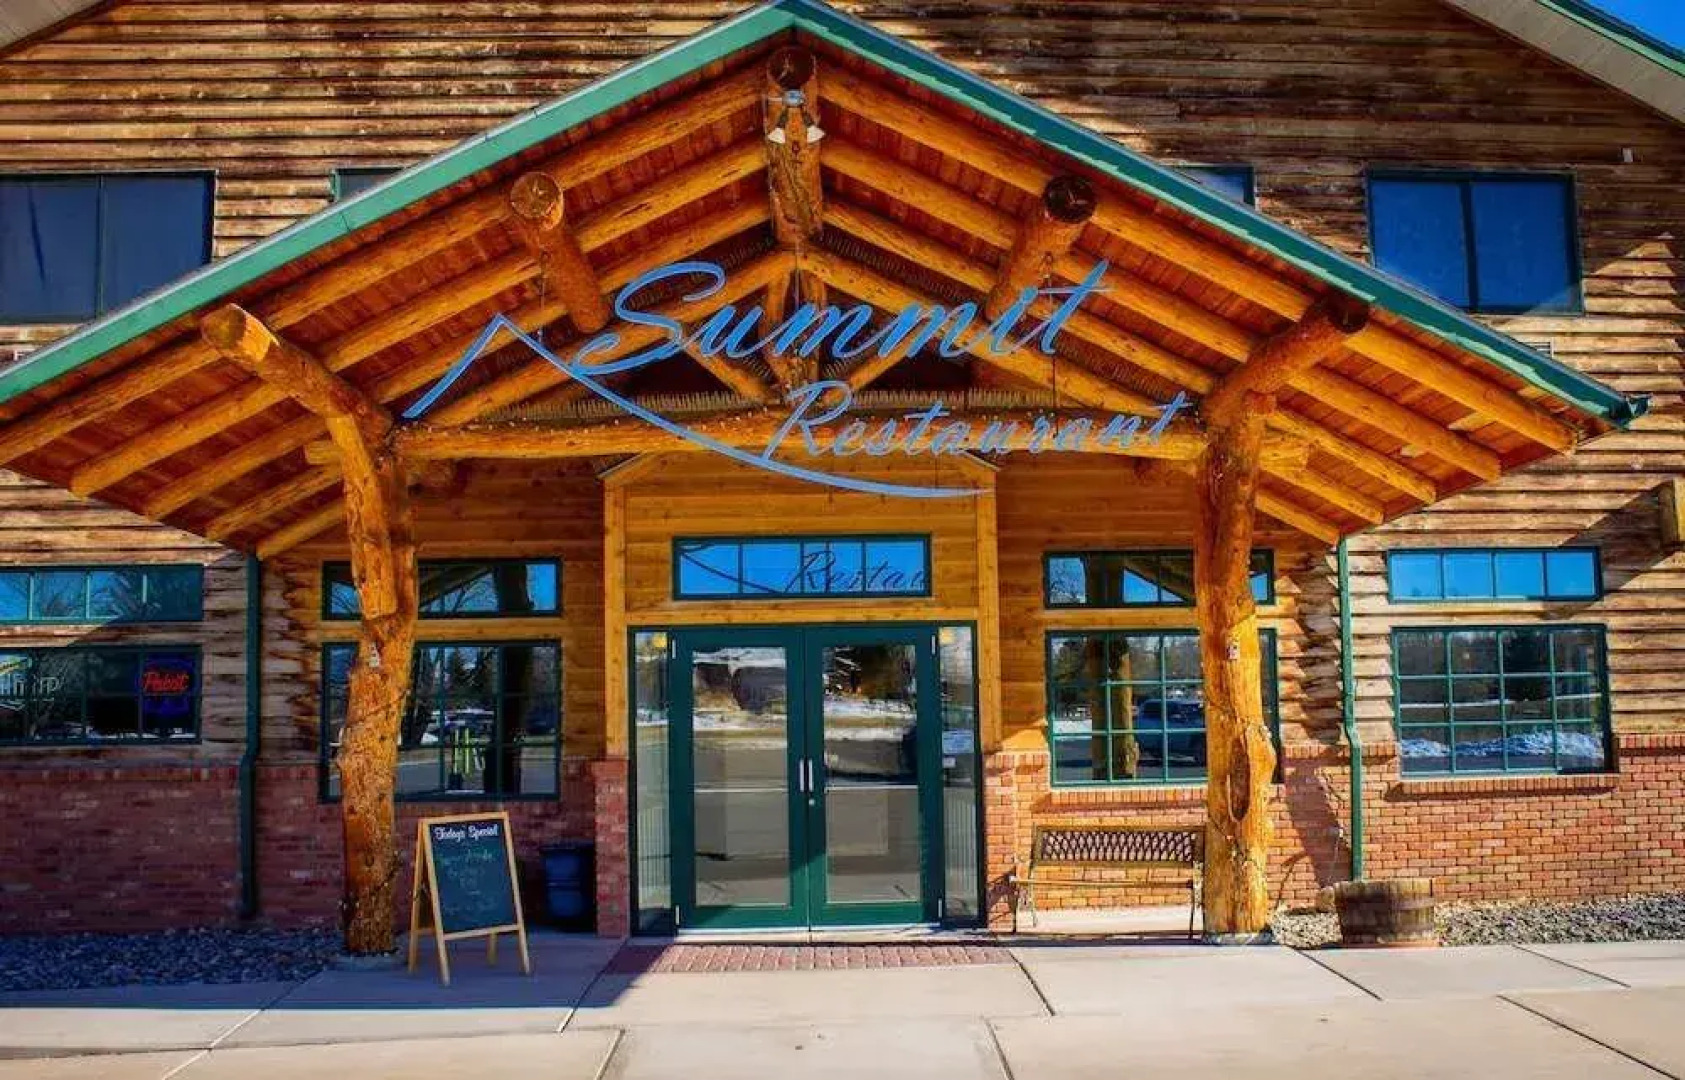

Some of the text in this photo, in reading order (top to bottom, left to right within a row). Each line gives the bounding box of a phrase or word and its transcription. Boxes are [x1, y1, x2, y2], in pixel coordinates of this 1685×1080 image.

[571, 261, 1110, 376] Summit
[762, 380, 1190, 460] Restaurant
[468, 823, 498, 841] Special
